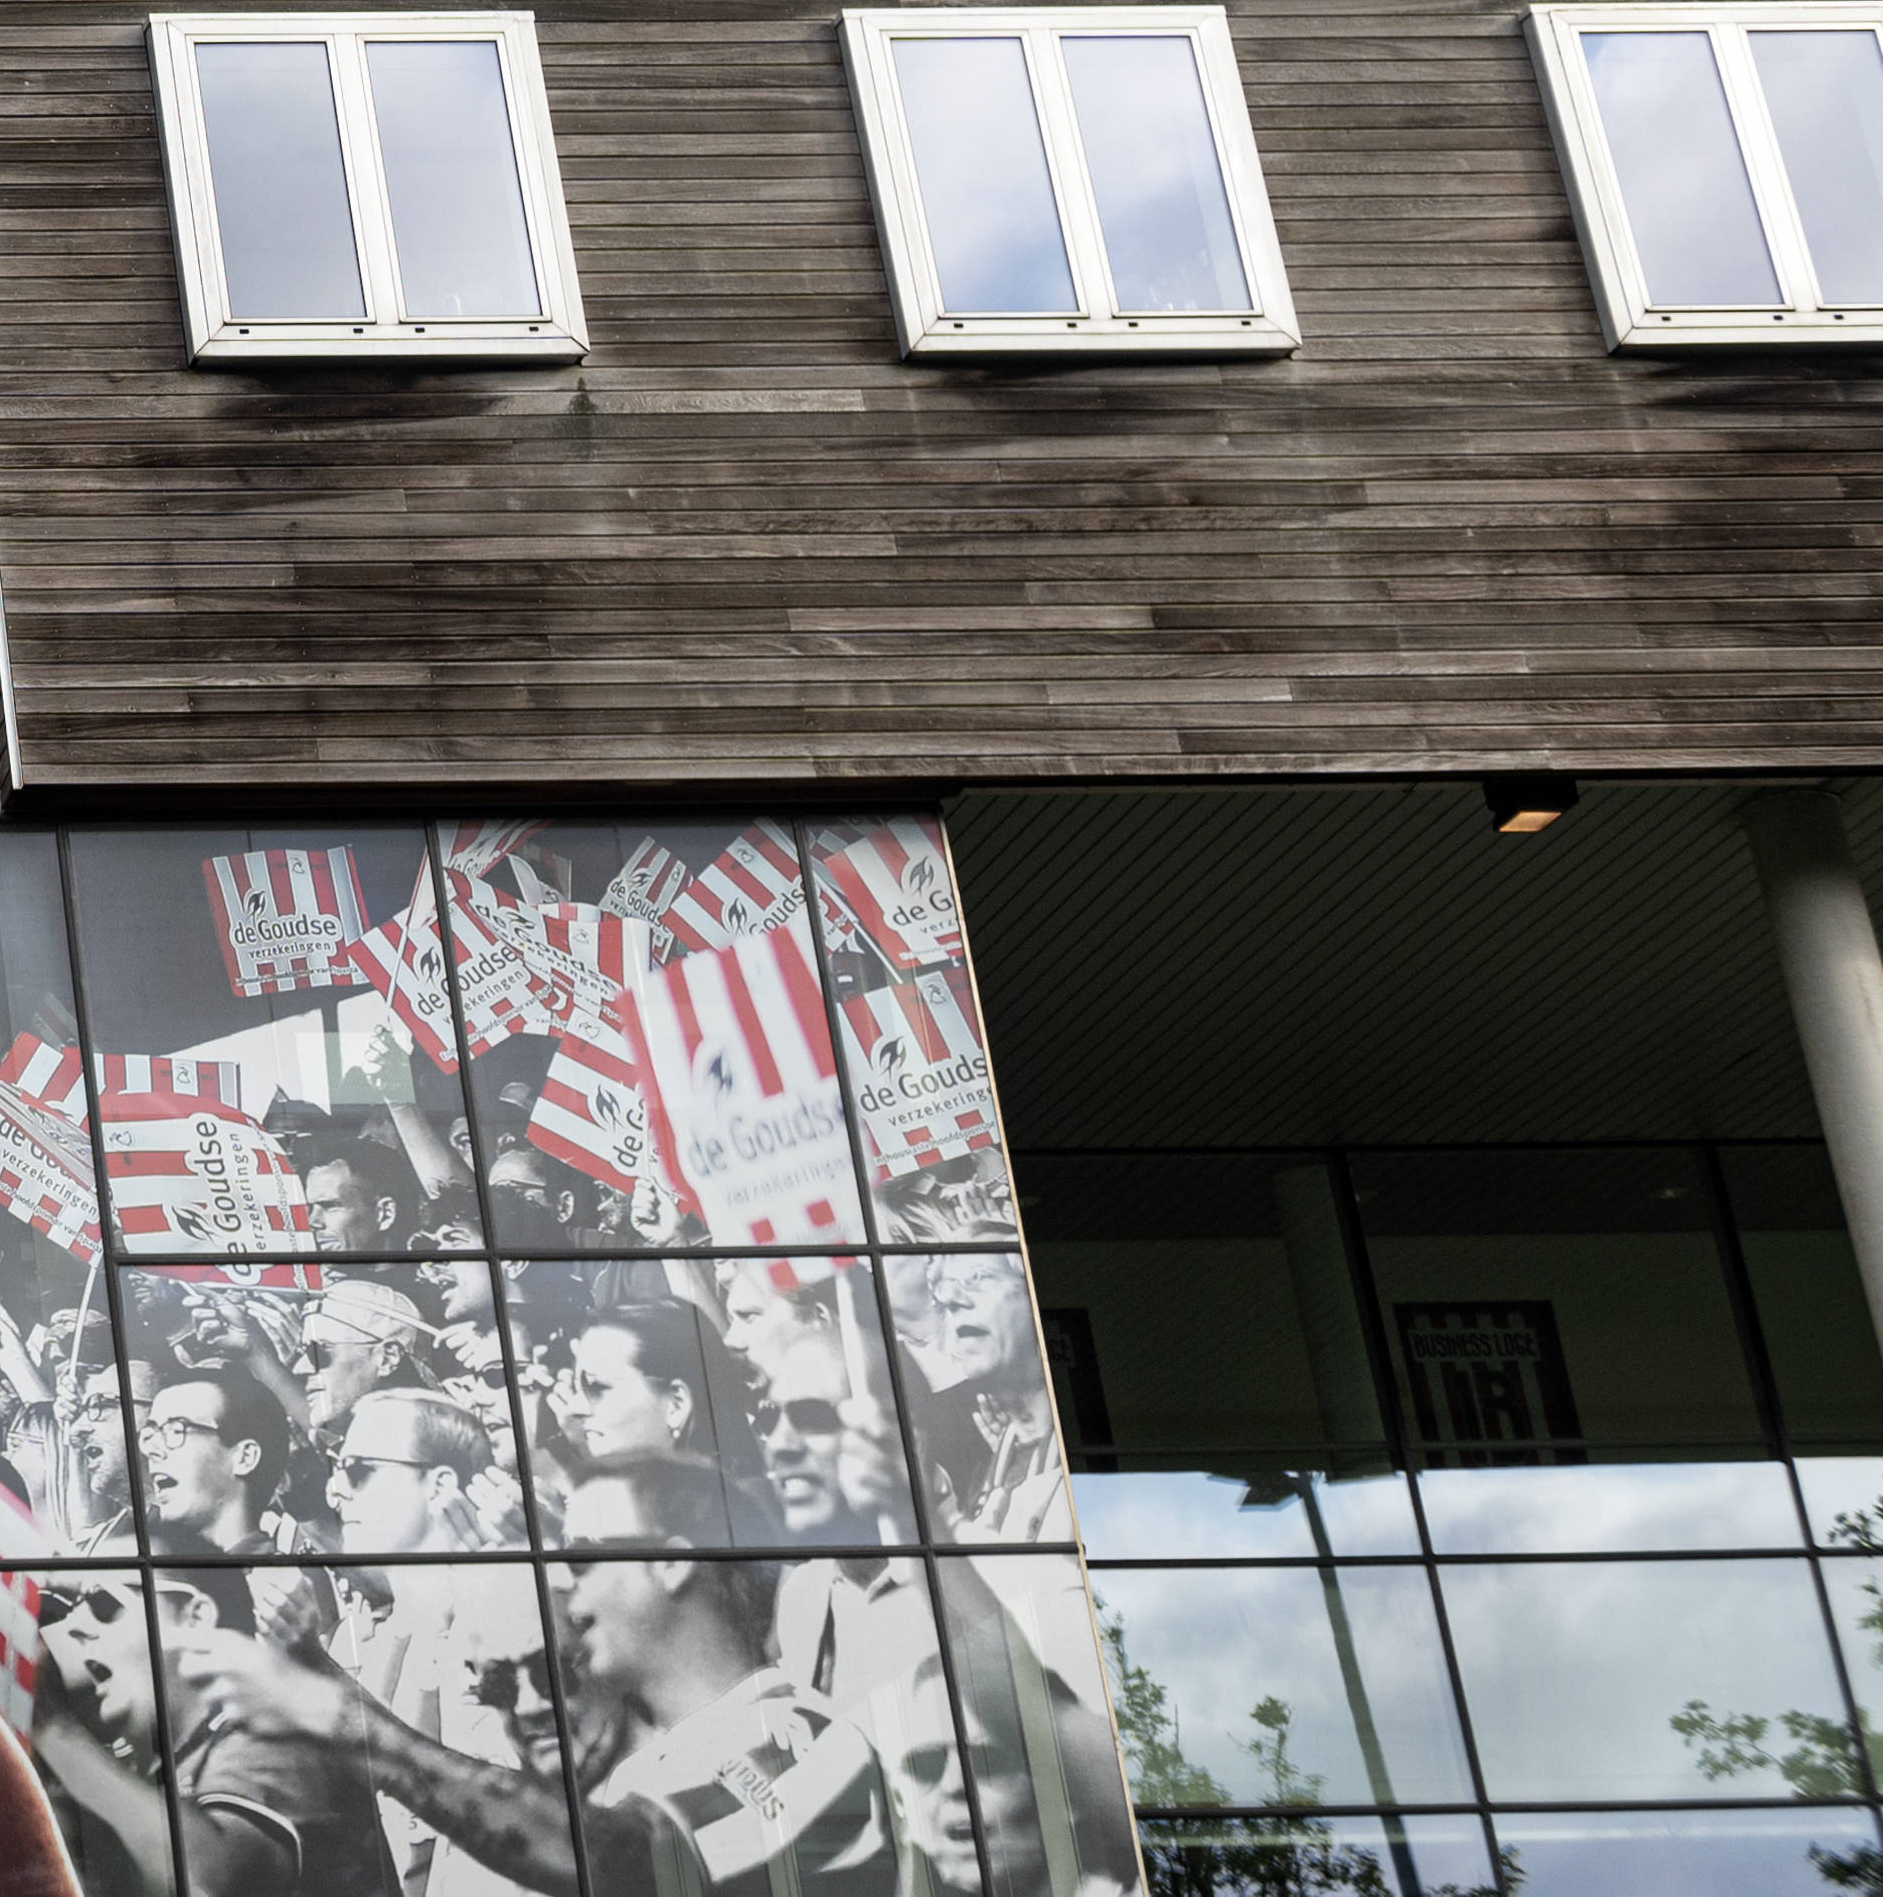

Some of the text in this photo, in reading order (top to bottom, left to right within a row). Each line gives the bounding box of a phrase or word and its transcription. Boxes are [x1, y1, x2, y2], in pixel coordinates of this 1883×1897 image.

[611, 879, 626, 898] de
[234, 914, 337, 945] de Goudse
[893, 905, 928, 927] de
[248, 941, 331, 960] verzekeringen
[513, 926, 623, 992] Goudse
[418, 991, 445, 1016] de
[859, 1054, 989, 1113] de Gouds
[888, 1086, 992, 1127] verzekering
[613, 1135, 643, 1168] de
[687, 1128, 728, 1178] de
[2, 1148, 97, 1217] verzekeringen
[193, 1120, 242, 1233] Goudse
[230, 1133, 267, 1251] erzekeringen
[1412, 1332, 1537, 1358] BUSINESS LOGE
